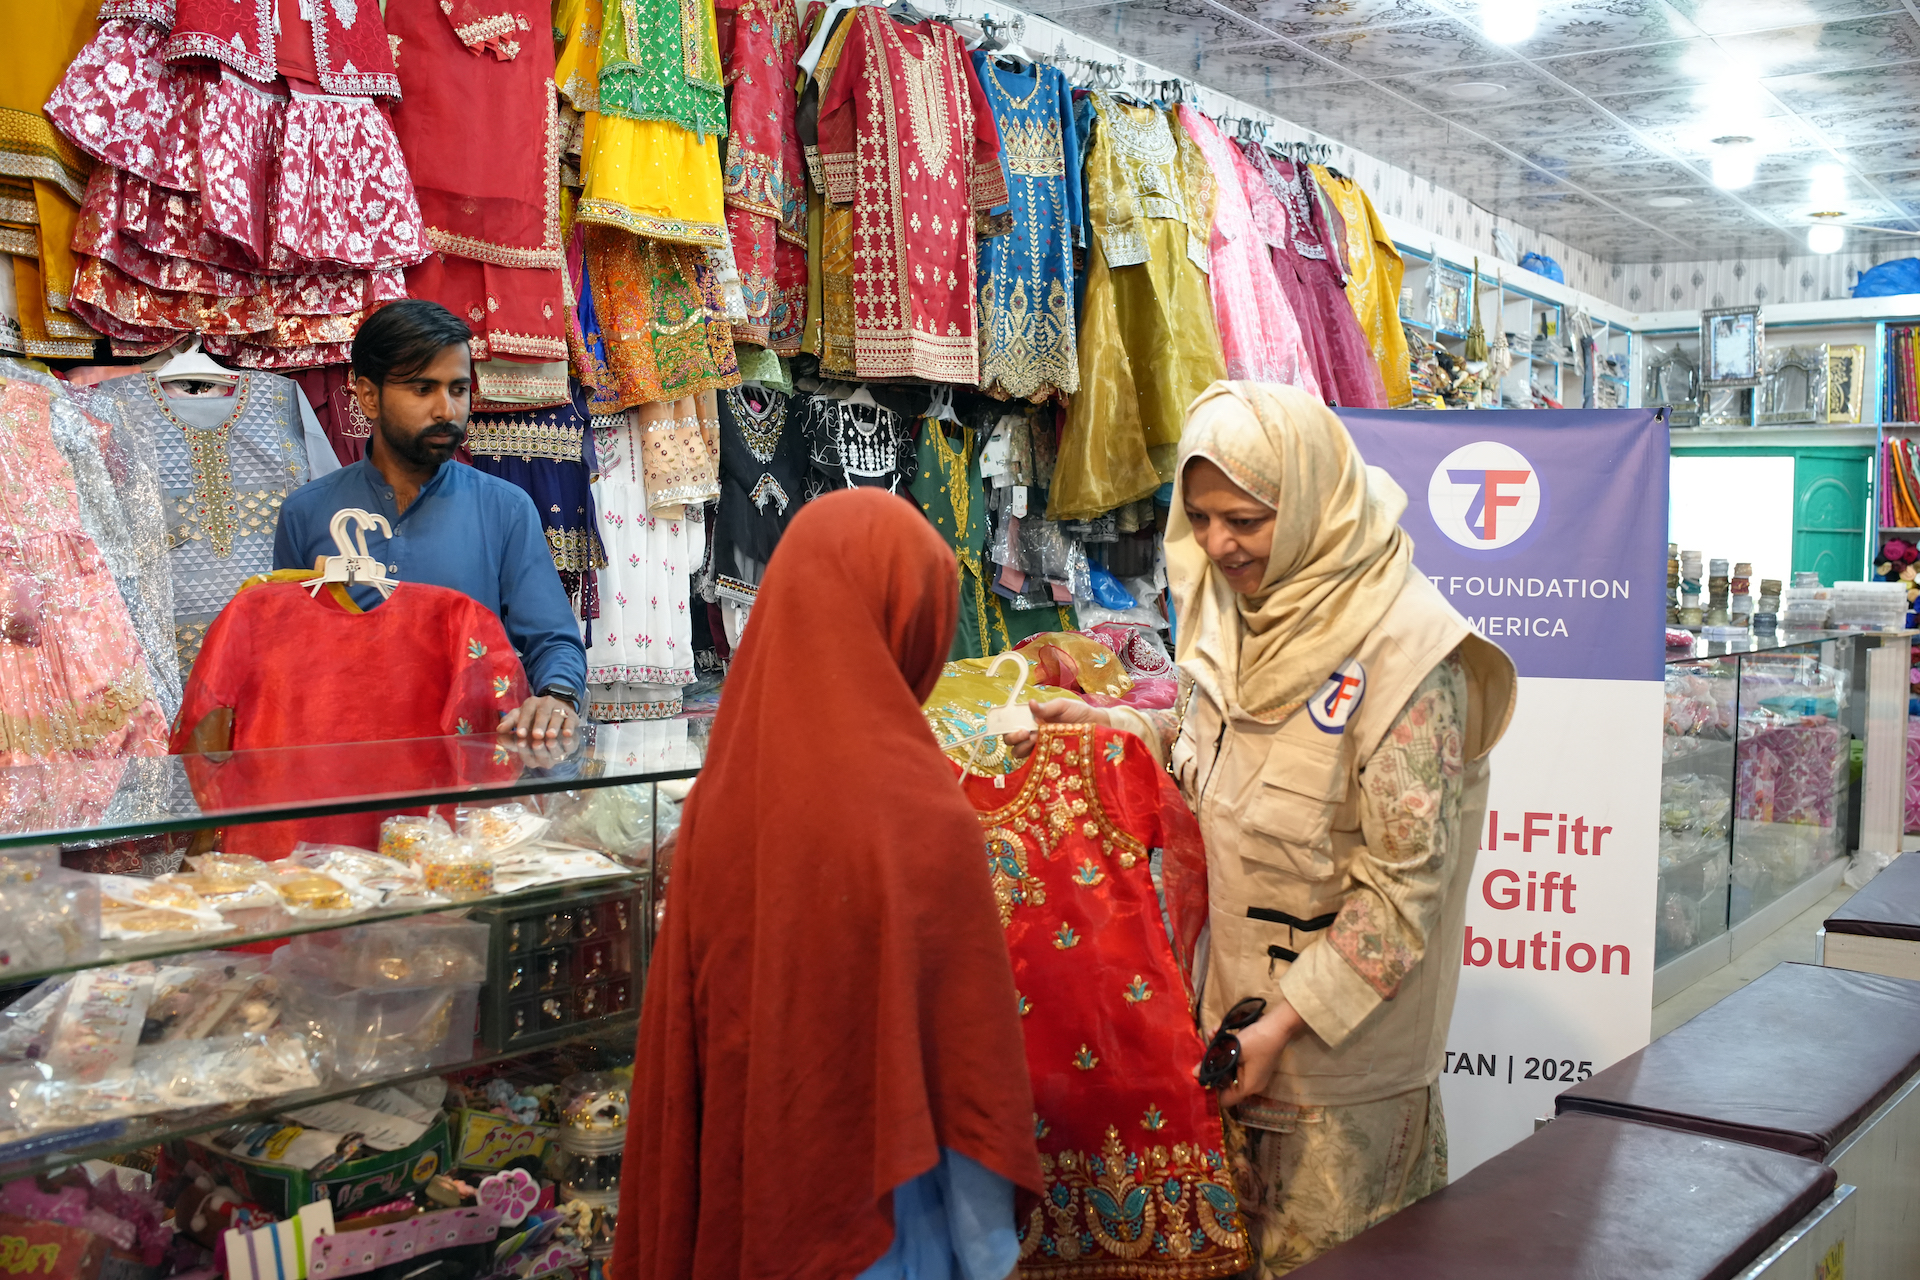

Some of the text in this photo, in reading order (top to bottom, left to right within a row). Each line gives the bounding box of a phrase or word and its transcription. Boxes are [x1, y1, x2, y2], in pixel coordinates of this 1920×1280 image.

[1449, 576, 1630, 600] FOUNDATION
[1477, 810, 1613, 856] l-Fitr
[1482, 868, 1577, 914] Gift
[1523, 1057, 1593, 1083] 2025
